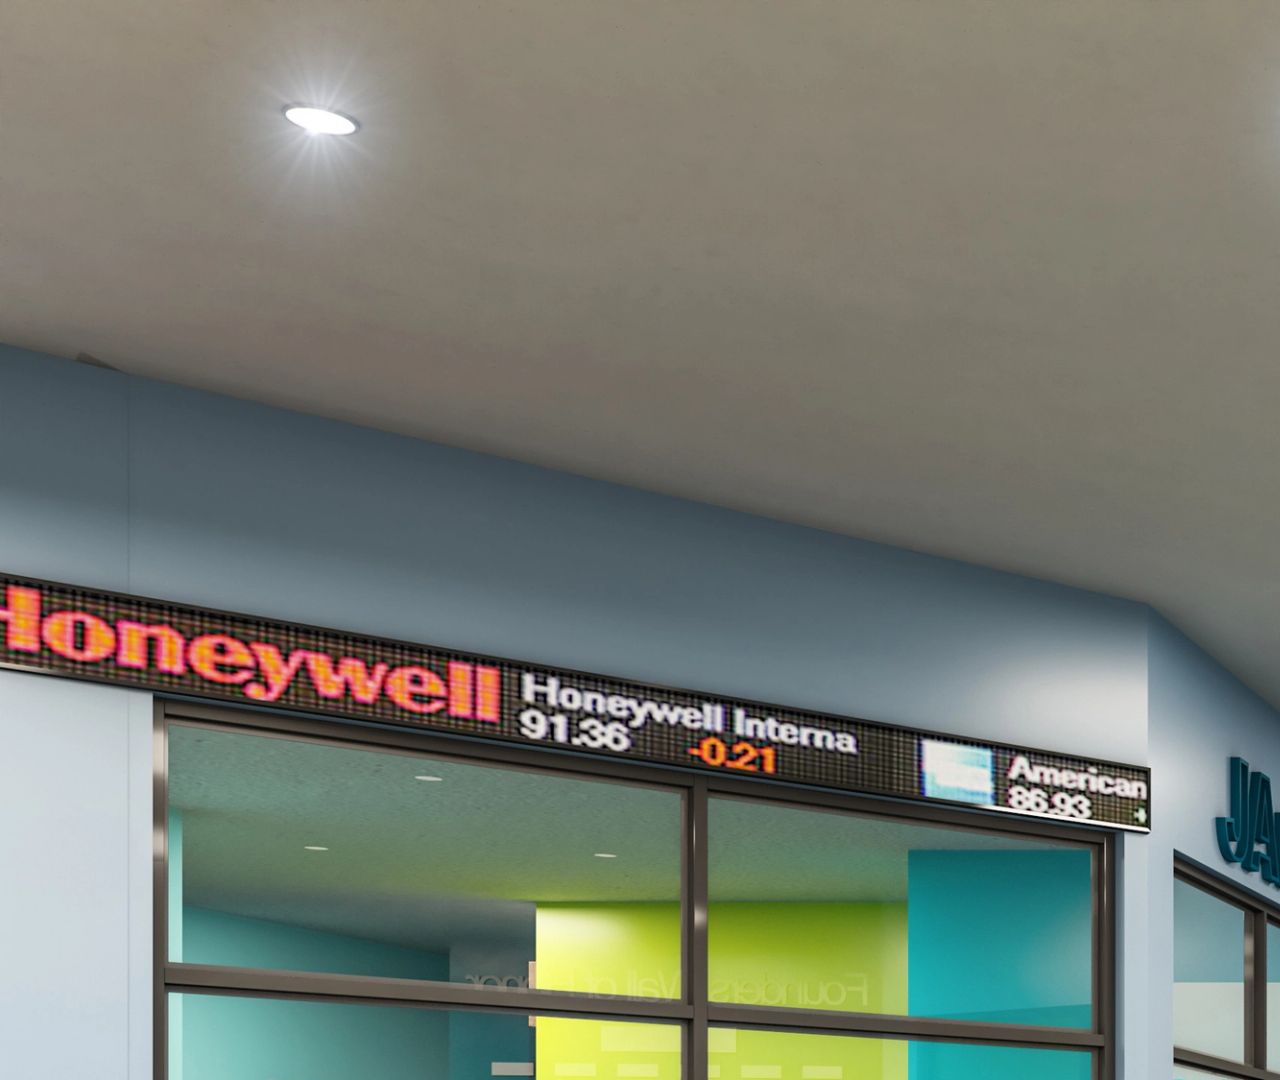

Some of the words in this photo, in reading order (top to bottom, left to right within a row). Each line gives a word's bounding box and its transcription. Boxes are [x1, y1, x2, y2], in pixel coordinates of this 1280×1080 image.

[519, 708, 633, 752] 91.36
[688, 736, 776, 775] -0.21
[522, 672, 724, 732] Honeywell
[734, 707, 858, 754] Interna
[1008, 755, 1148, 800] American
[1008, 785, 1093, 819] 86.93
[1215, 757, 1280, 889] JA
